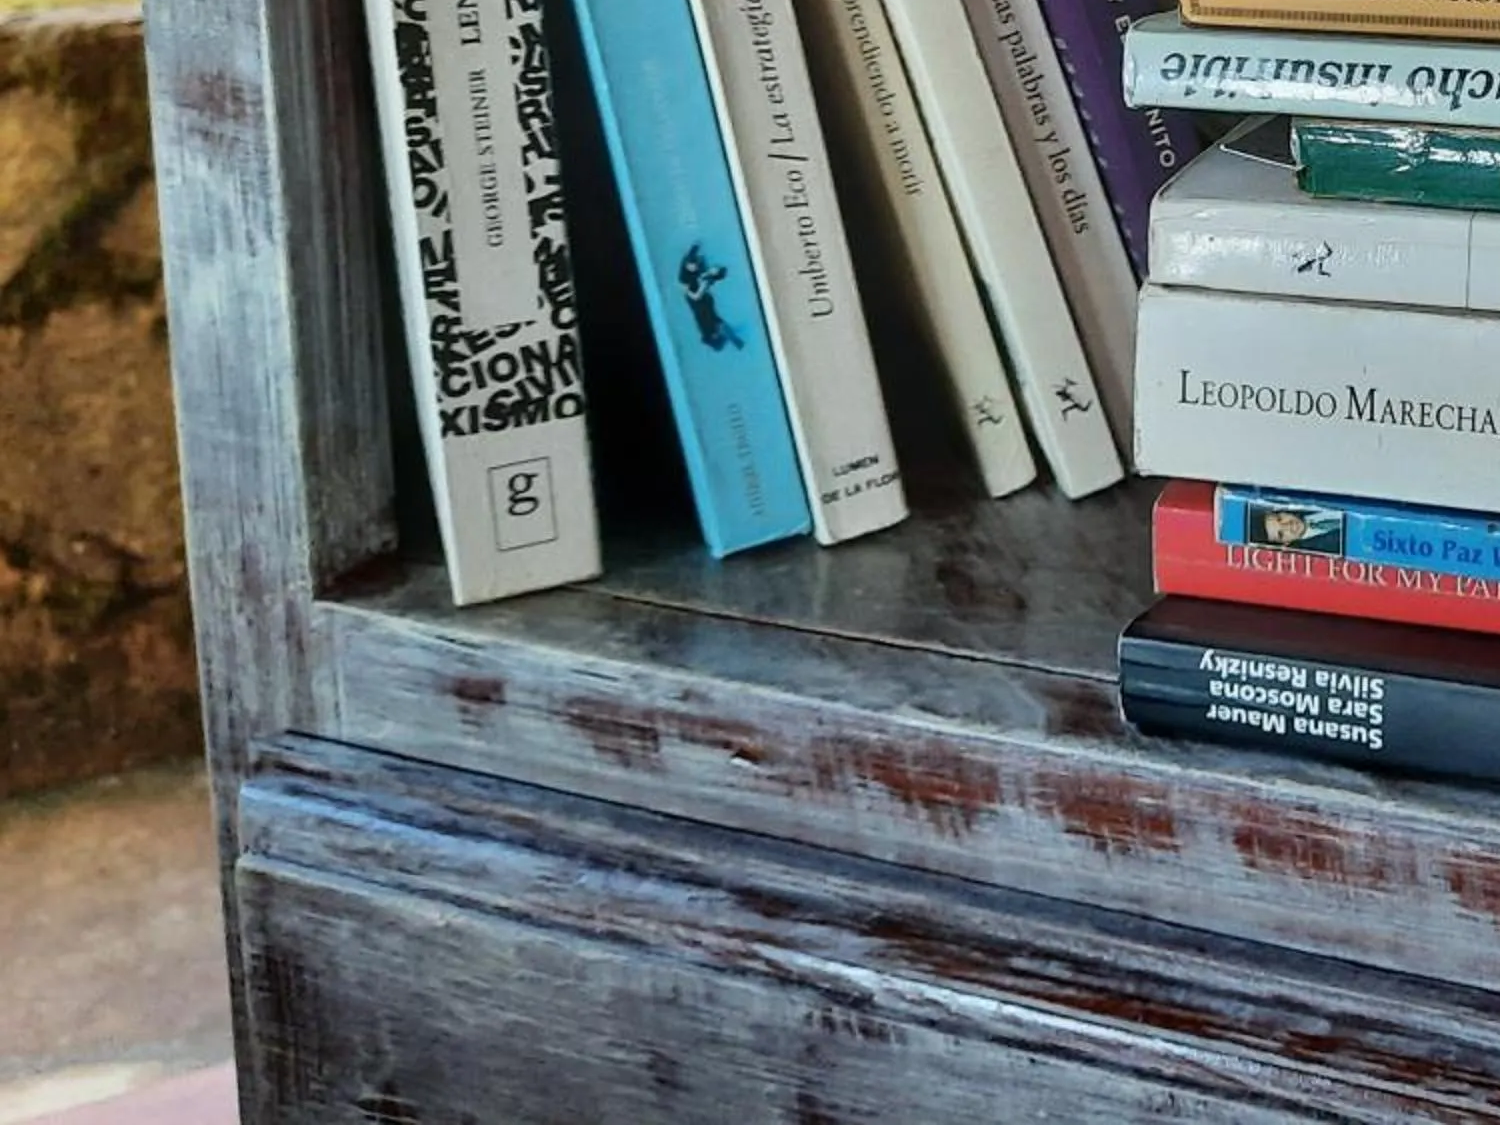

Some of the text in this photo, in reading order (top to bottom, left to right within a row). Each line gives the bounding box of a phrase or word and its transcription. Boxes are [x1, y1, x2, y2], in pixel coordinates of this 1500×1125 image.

[771, 109, 796, 147] La
[999, 31, 1047, 128] palabras
[1035, 129, 1059, 145] y
[1048, 147, 1071, 186] los
[1060, 190, 1091, 236] días
[468, 68, 505, 249] GEORGE STEINER
[782, 169, 811, 210] Eco
[797, 214, 834, 319] Umberto
[821, 488, 840, 505] DE
[843, 483, 863, 500] LA
[1372, 528, 1434, 560] Sixto
[1442, 537, 1483, 567] Paz
[1395, 565, 1451, 595] MY
[1199, 650, 1385, 700] Silvia Resnizky
[1208, 679, 1384, 725] Sara Moscona
[1206, 704, 1384, 750] Susana Mauer
